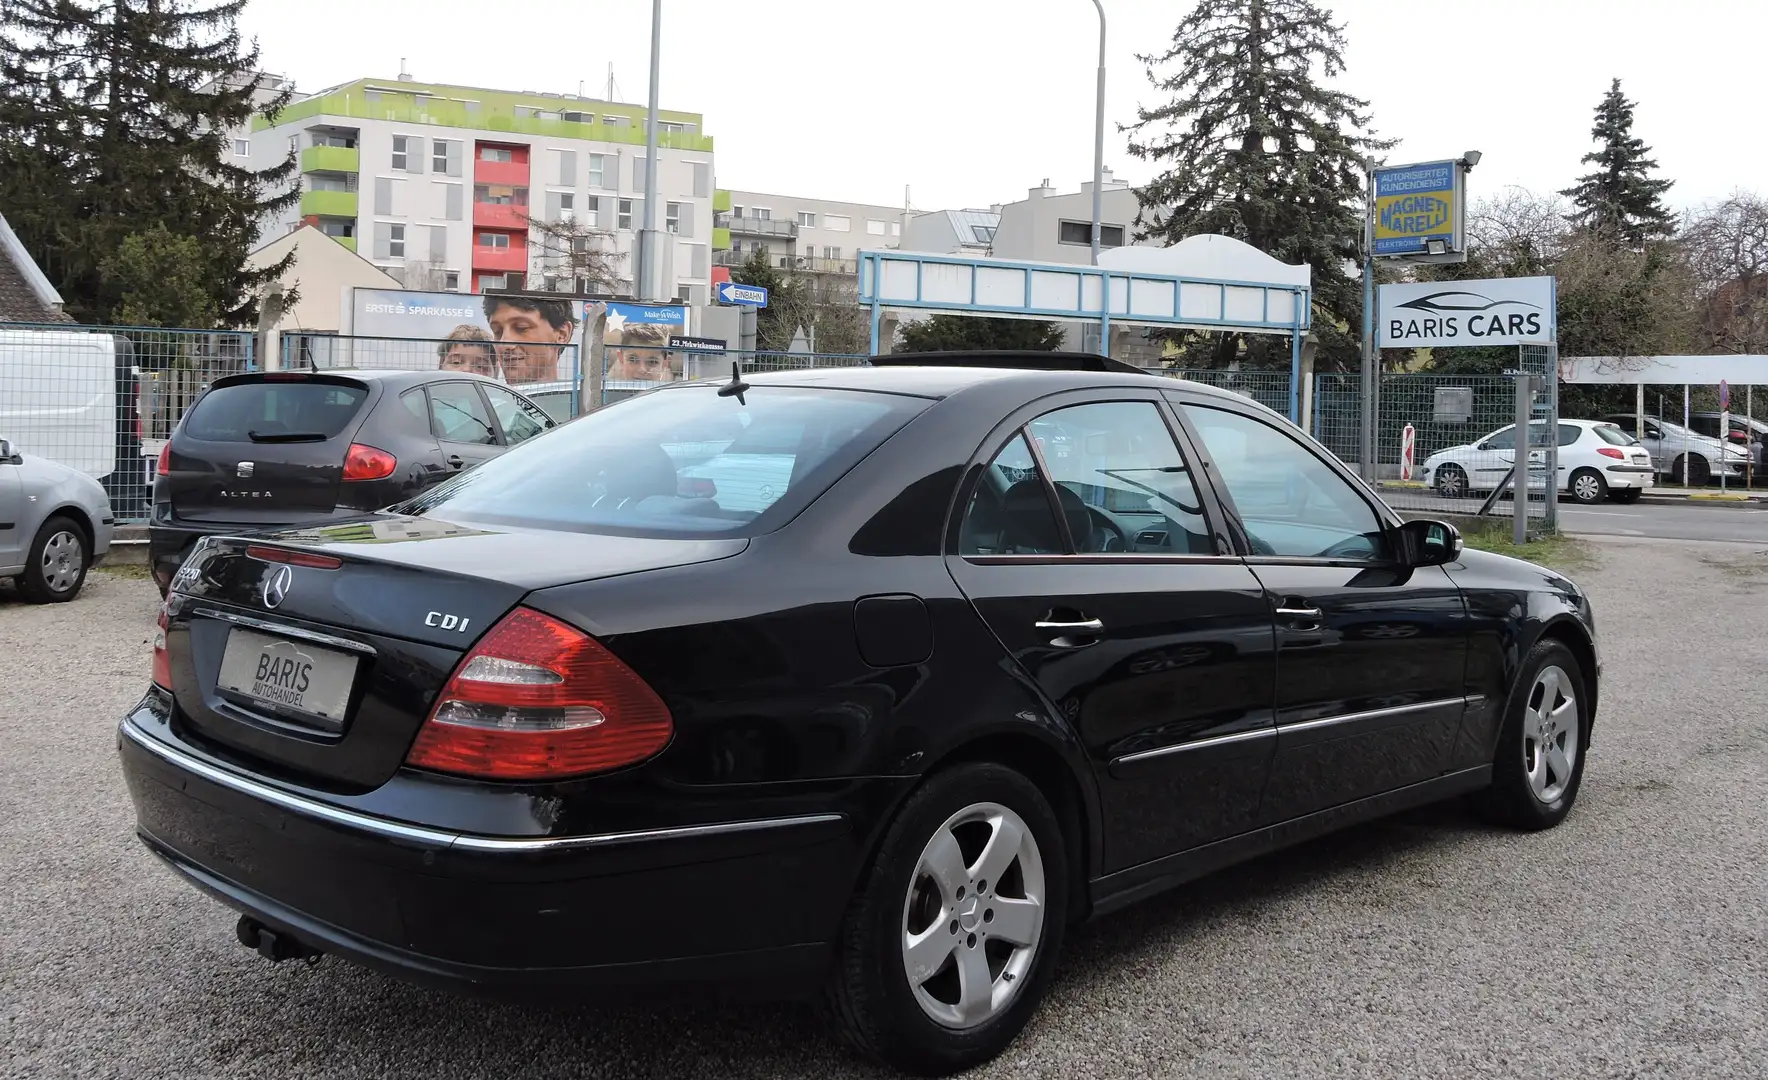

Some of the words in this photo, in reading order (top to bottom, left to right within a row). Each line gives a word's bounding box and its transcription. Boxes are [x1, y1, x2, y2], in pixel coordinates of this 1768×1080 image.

[1381, 168, 1449, 182] AUTORISIERTER
[1381, 177, 1449, 192] KUNDENDIENST
[735, 290, 762, 301] EINBAHN
[365, 303, 395, 314] ERSTE
[408, 306, 463, 318] SPARKASSE
[1390, 317, 1458, 339] BARIS
[1467, 312, 1541, 337] CARS
[220, 490, 272, 498] ALTEA
[424, 611, 470, 632] CDI
[255, 652, 313, 693] BARIS
[251, 681, 304, 707] AUTOHANDEL
